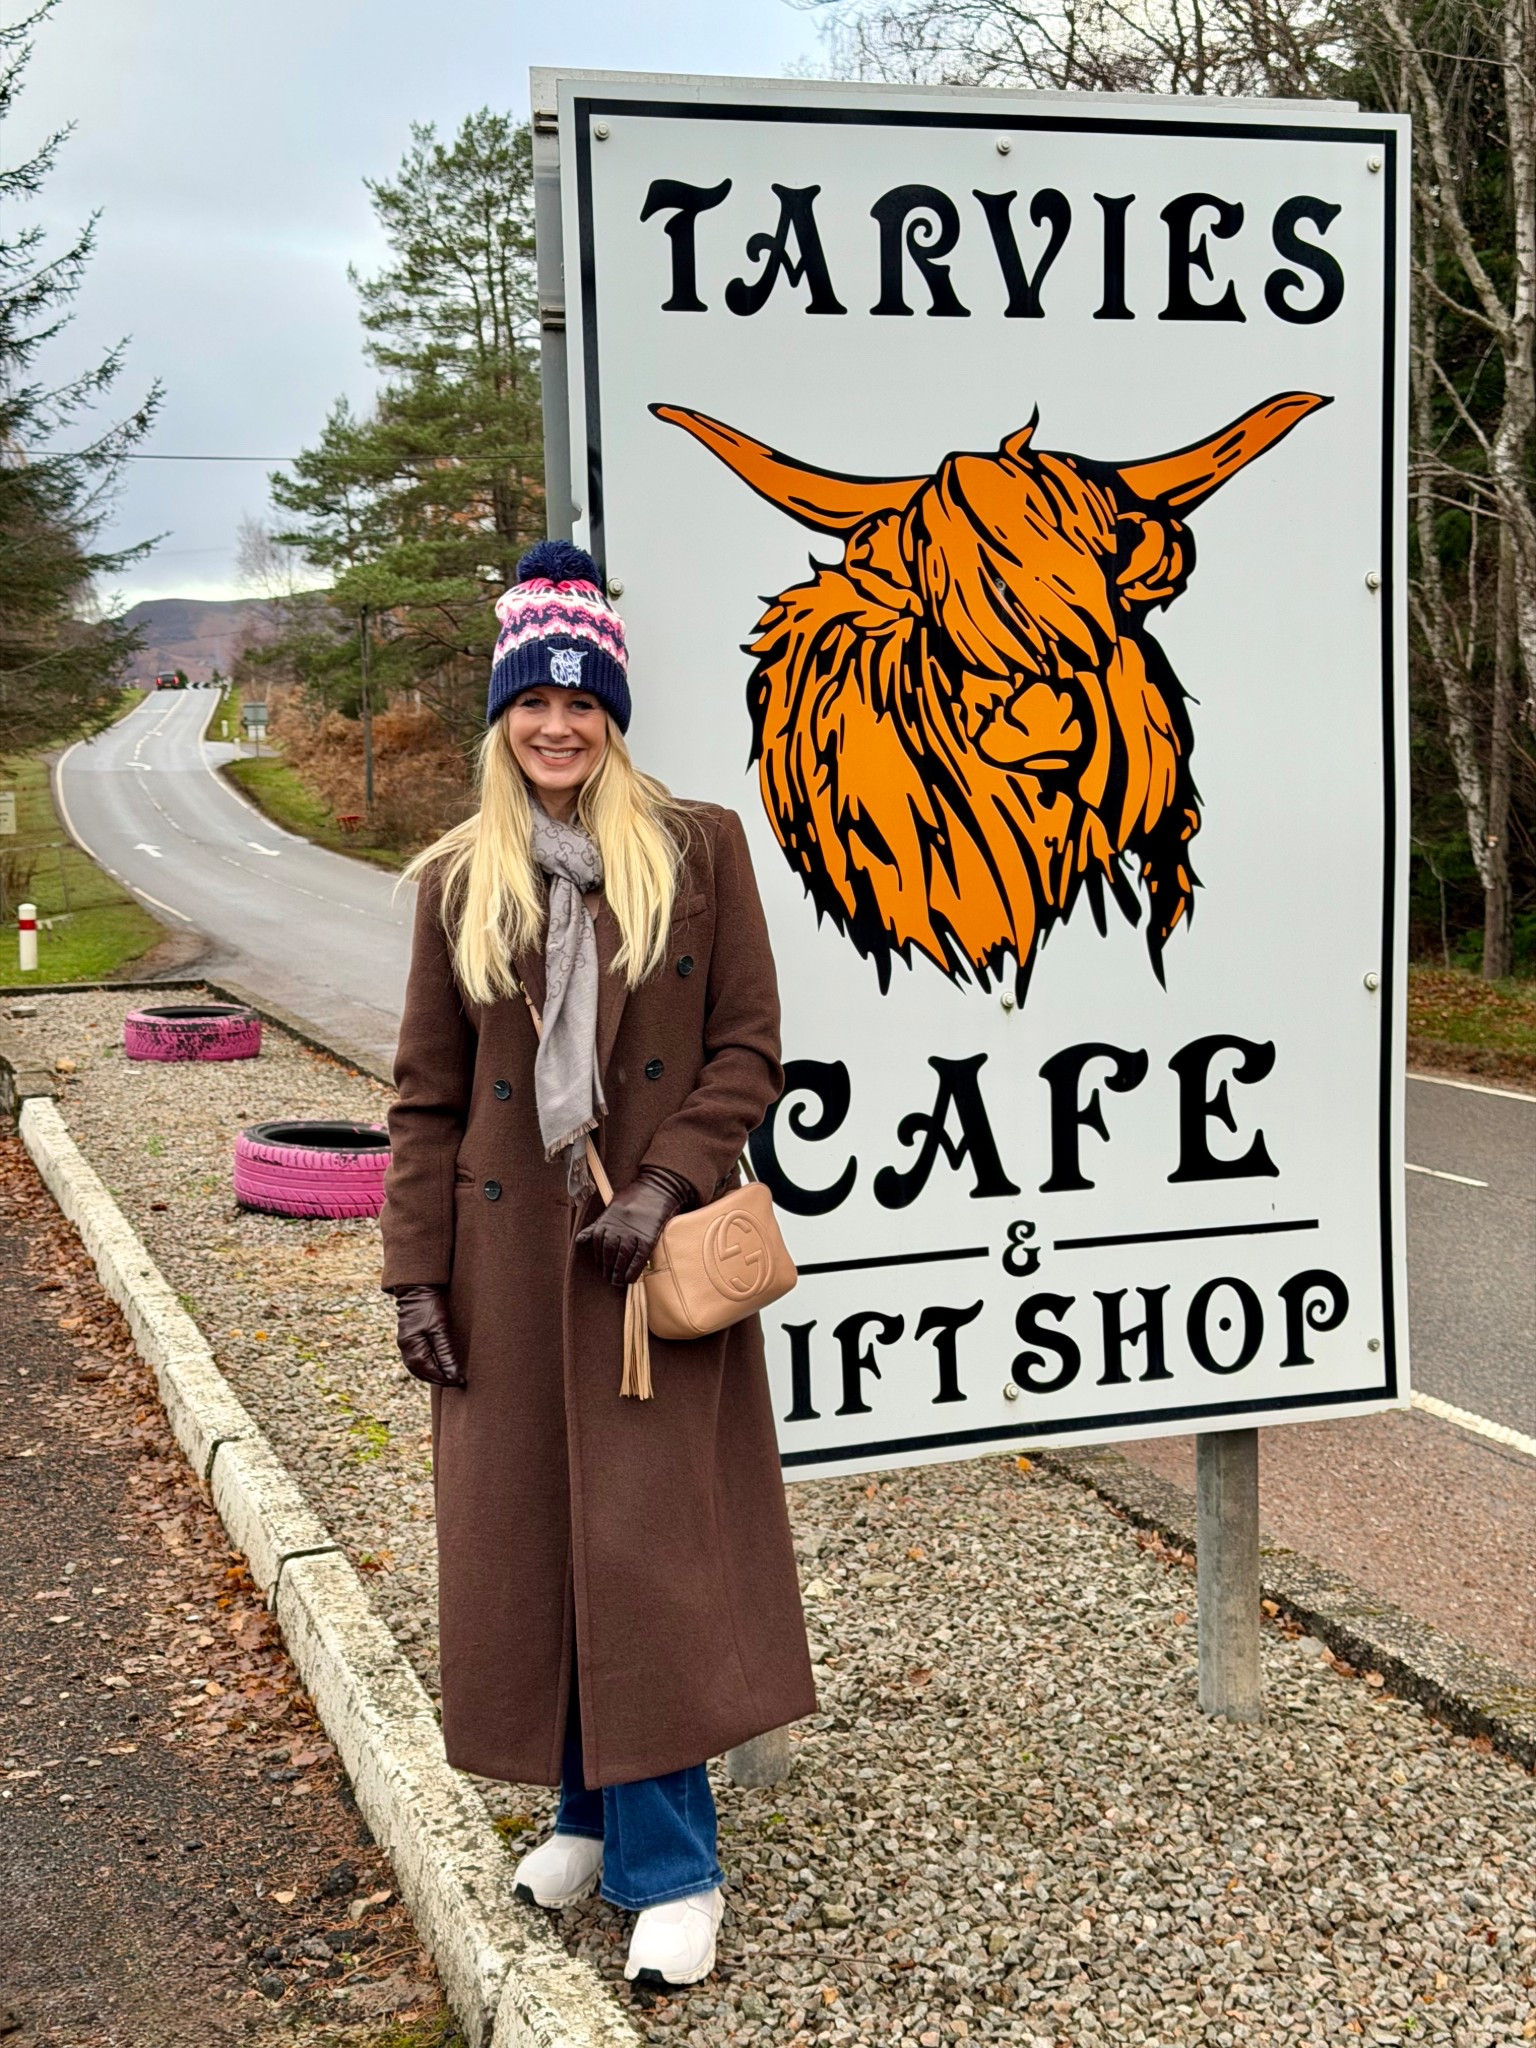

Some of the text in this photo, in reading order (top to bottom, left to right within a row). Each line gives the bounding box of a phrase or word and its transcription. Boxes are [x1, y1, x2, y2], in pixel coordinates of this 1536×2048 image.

[639, 177, 1345, 325] TARVIES
[749, 1033, 1280, 1216] CAFE
[1002, 1219, 1041, 1278] &
[780, 1268, 1350, 1423] IFT SHOP
